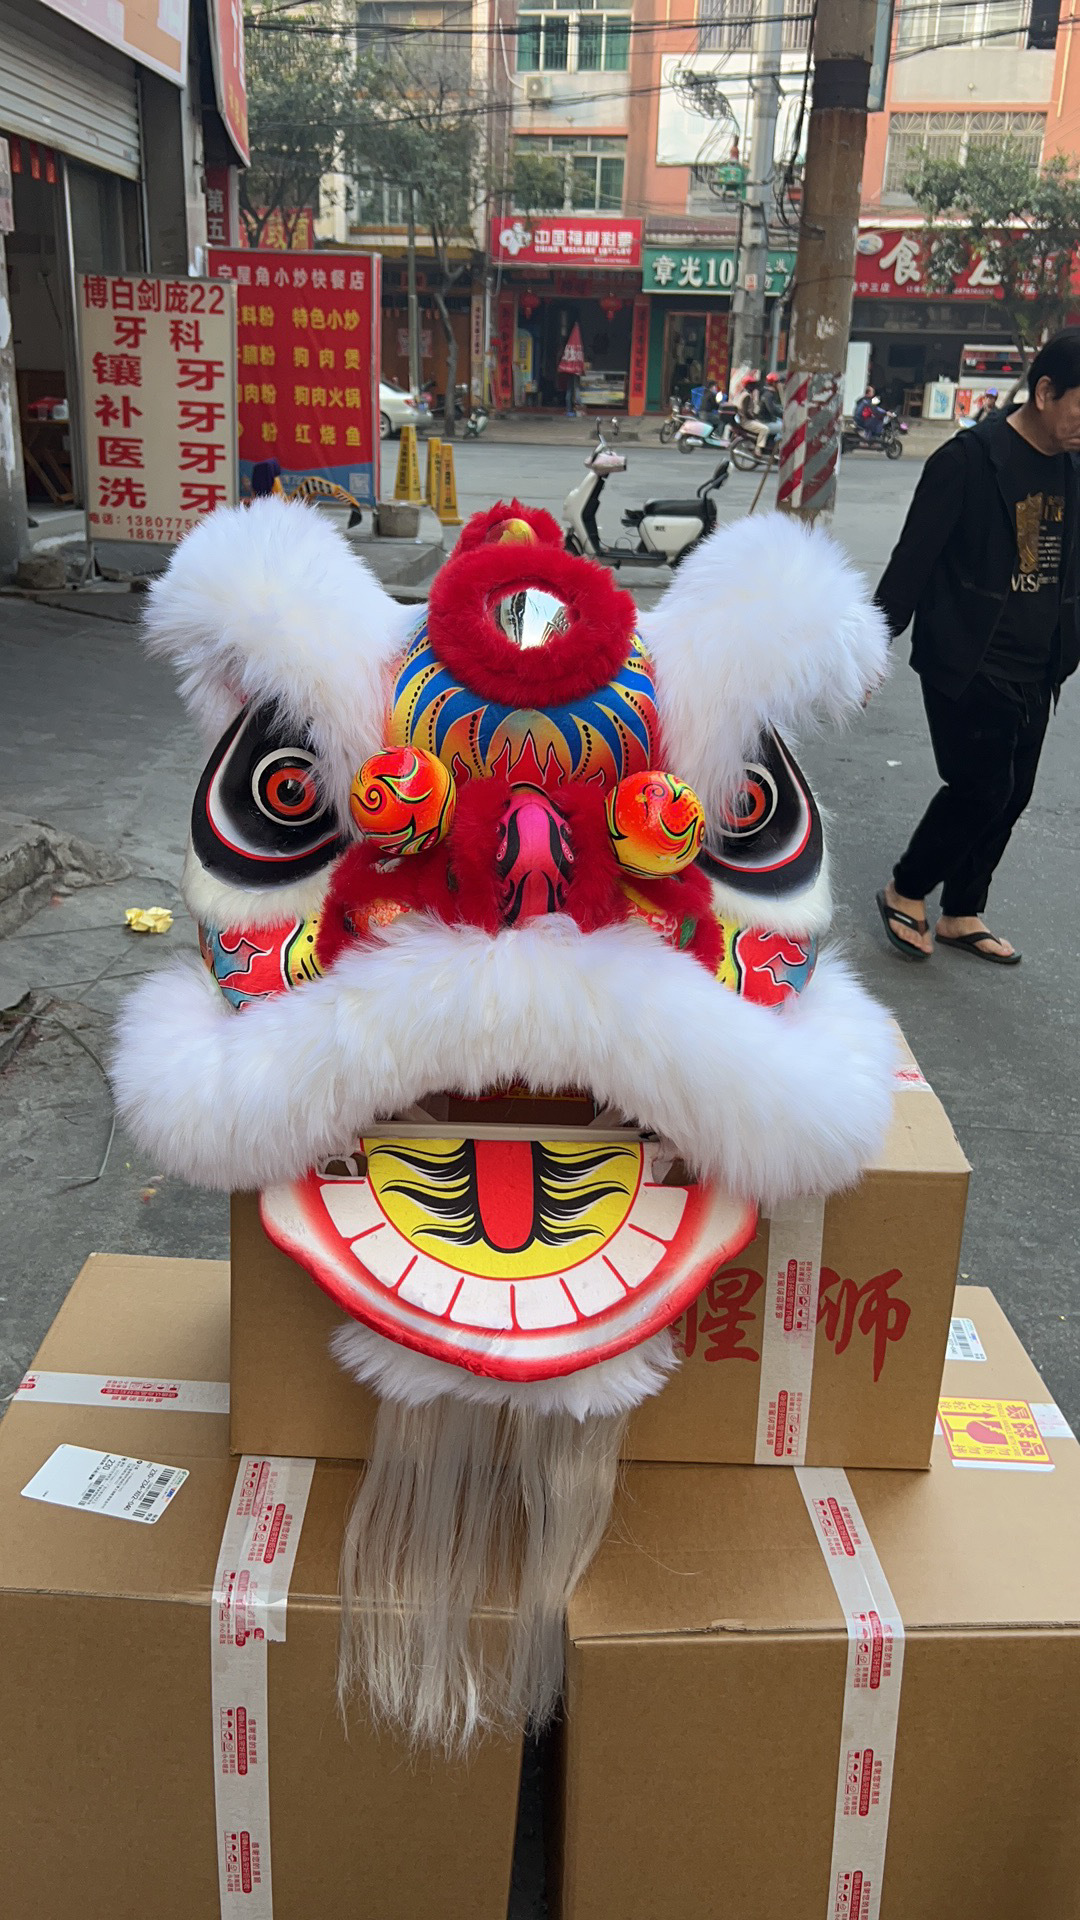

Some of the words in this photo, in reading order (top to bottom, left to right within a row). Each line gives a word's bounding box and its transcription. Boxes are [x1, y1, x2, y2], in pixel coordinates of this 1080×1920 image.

[237, 305, 275, 327] 料粉
[292, 307, 361, 331] 特色小炒
[294, 385, 361, 409] 狗肉火锅
[776, 1272, 785, 1318] 感谢您的惠顾
[766, 1402, 776, 1445] 感谢您的惠顾
[1005, 1404, 1046, 1456] 易碎品
